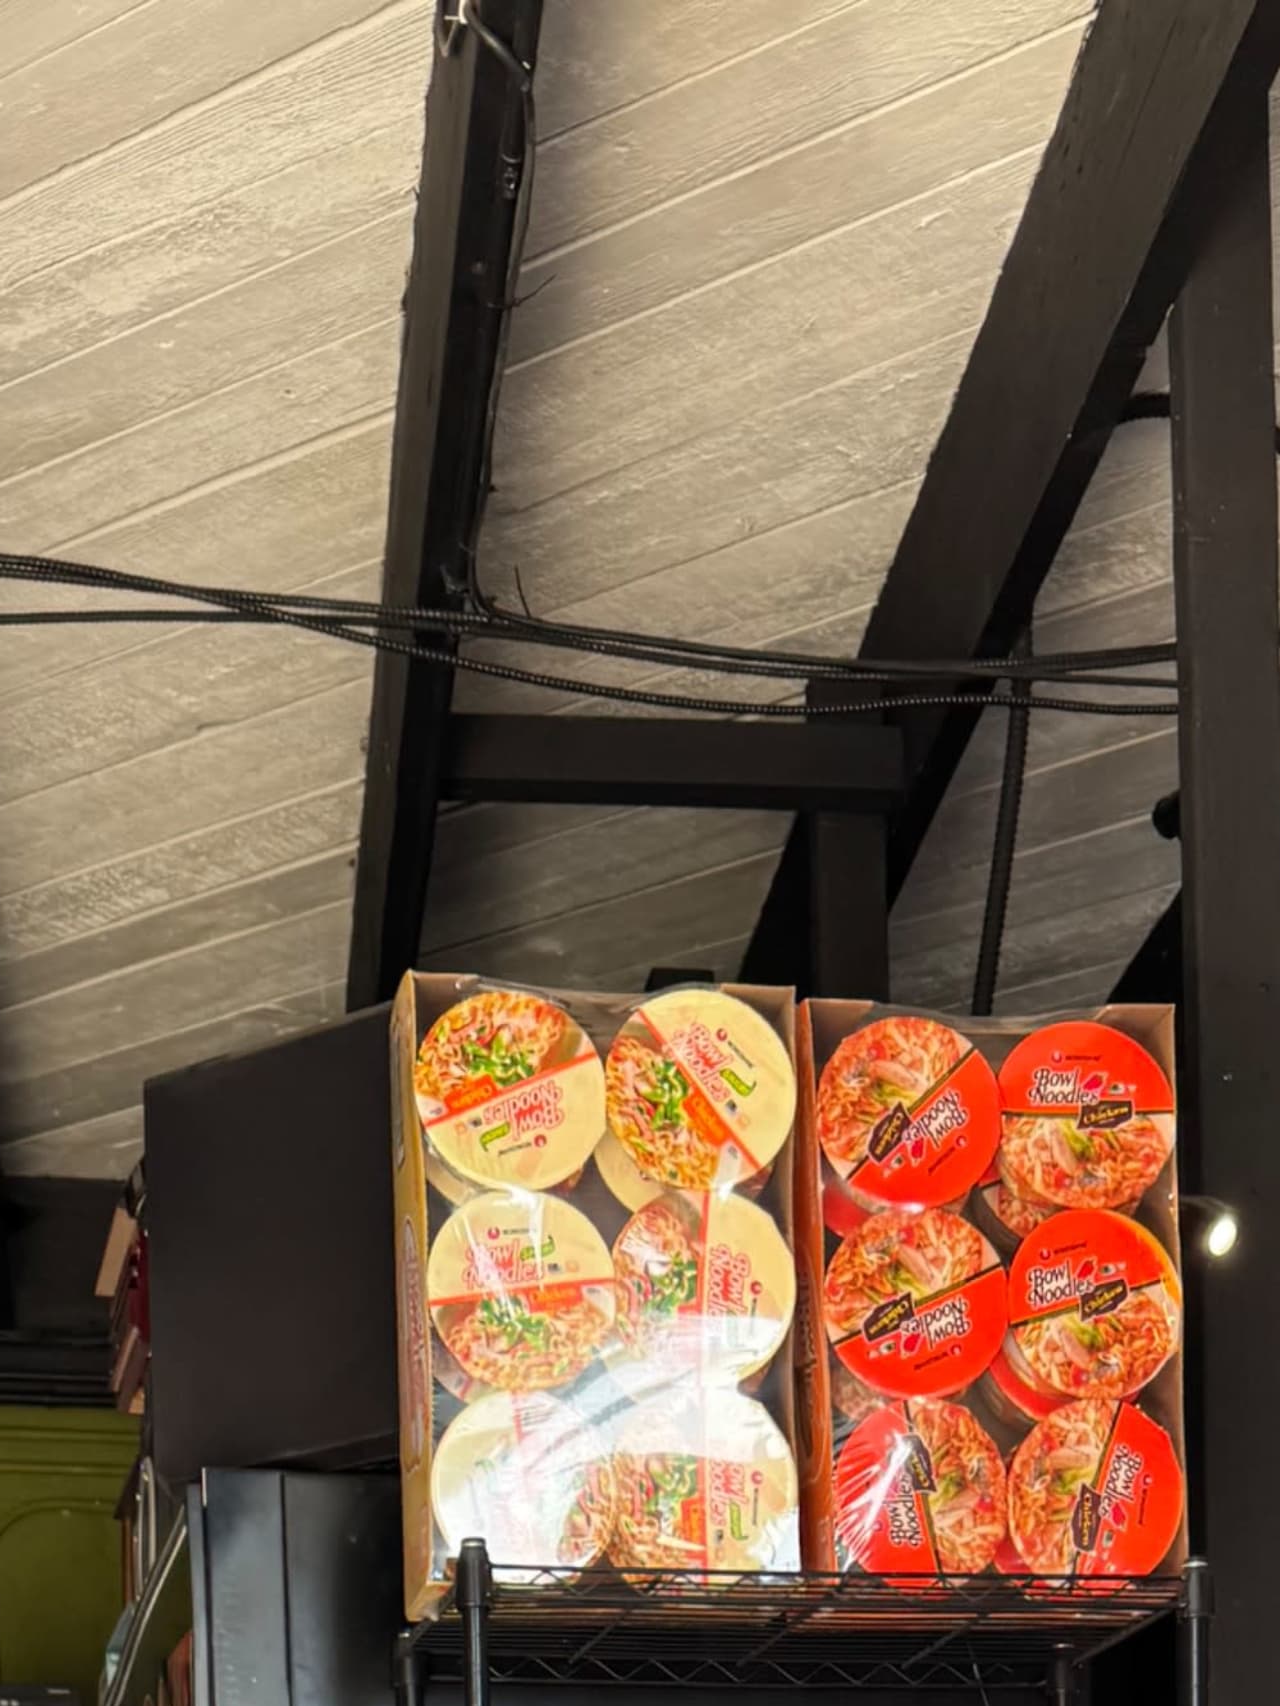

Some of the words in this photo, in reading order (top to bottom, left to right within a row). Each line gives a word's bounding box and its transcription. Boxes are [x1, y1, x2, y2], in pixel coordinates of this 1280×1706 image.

[1033, 1067, 1079, 1089] Bowl
[1028, 1087, 1100, 1106] Noodles
[901, 1089, 961, 1142] Noodles
[929, 1108, 969, 1149] Bowl
[1029, 1259, 1071, 1285] Bowl
[1028, 1278, 1094, 1307] Noodles
[900, 1297, 968, 1333] Noodles
[926, 1315, 970, 1350] Bowl
[1099, 1445, 1129, 1517] Noodles
[1120, 1453, 1143, 1501] Bowl
